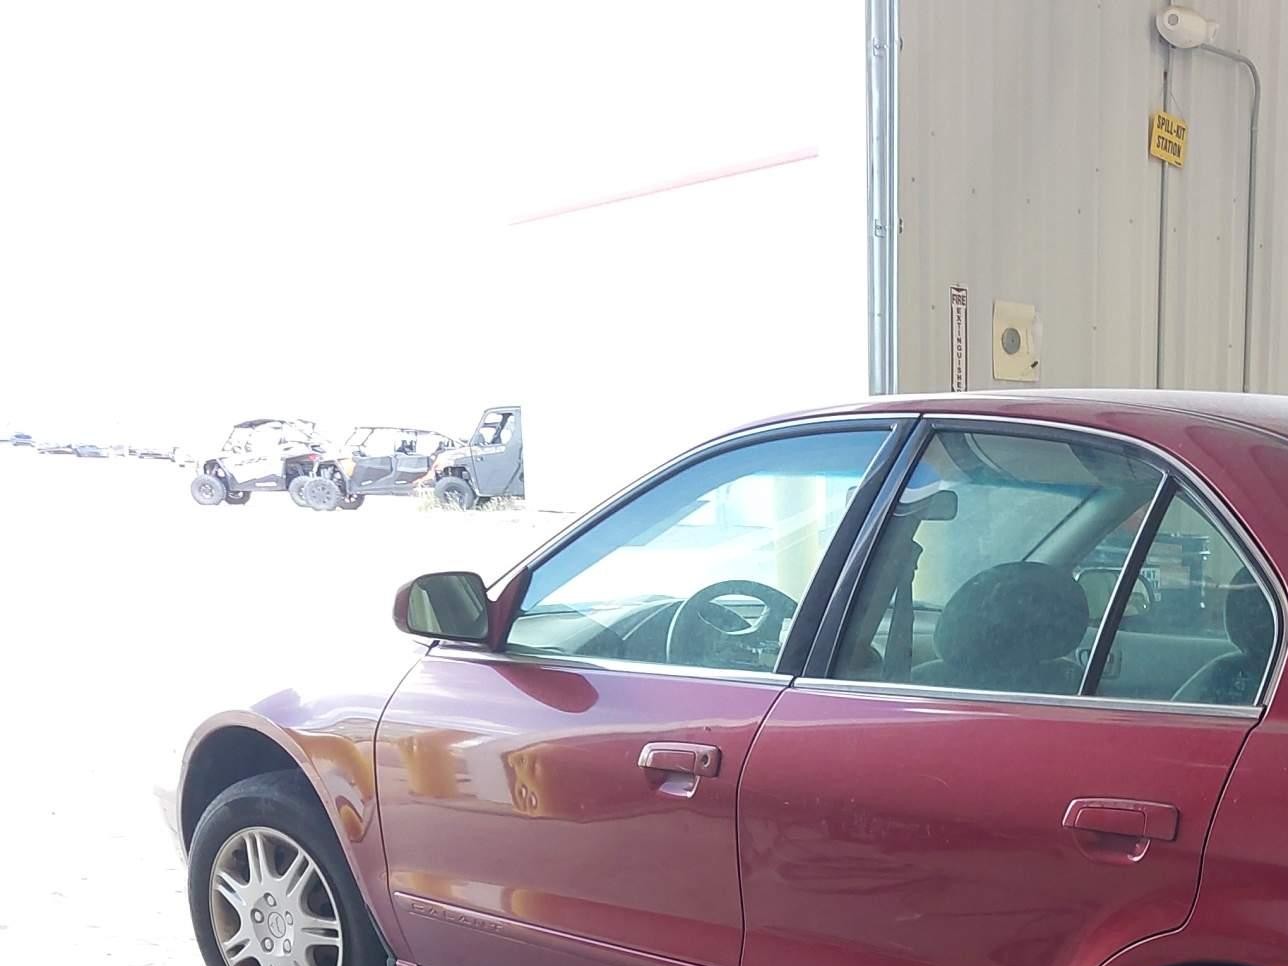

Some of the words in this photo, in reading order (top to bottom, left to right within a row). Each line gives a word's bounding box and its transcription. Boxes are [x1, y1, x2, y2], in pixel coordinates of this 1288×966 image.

[1156, 115, 1186, 141] SPILL-KIT
[1156, 135, 1182, 158] STATION
[952, 294, 966, 306] FIRE
